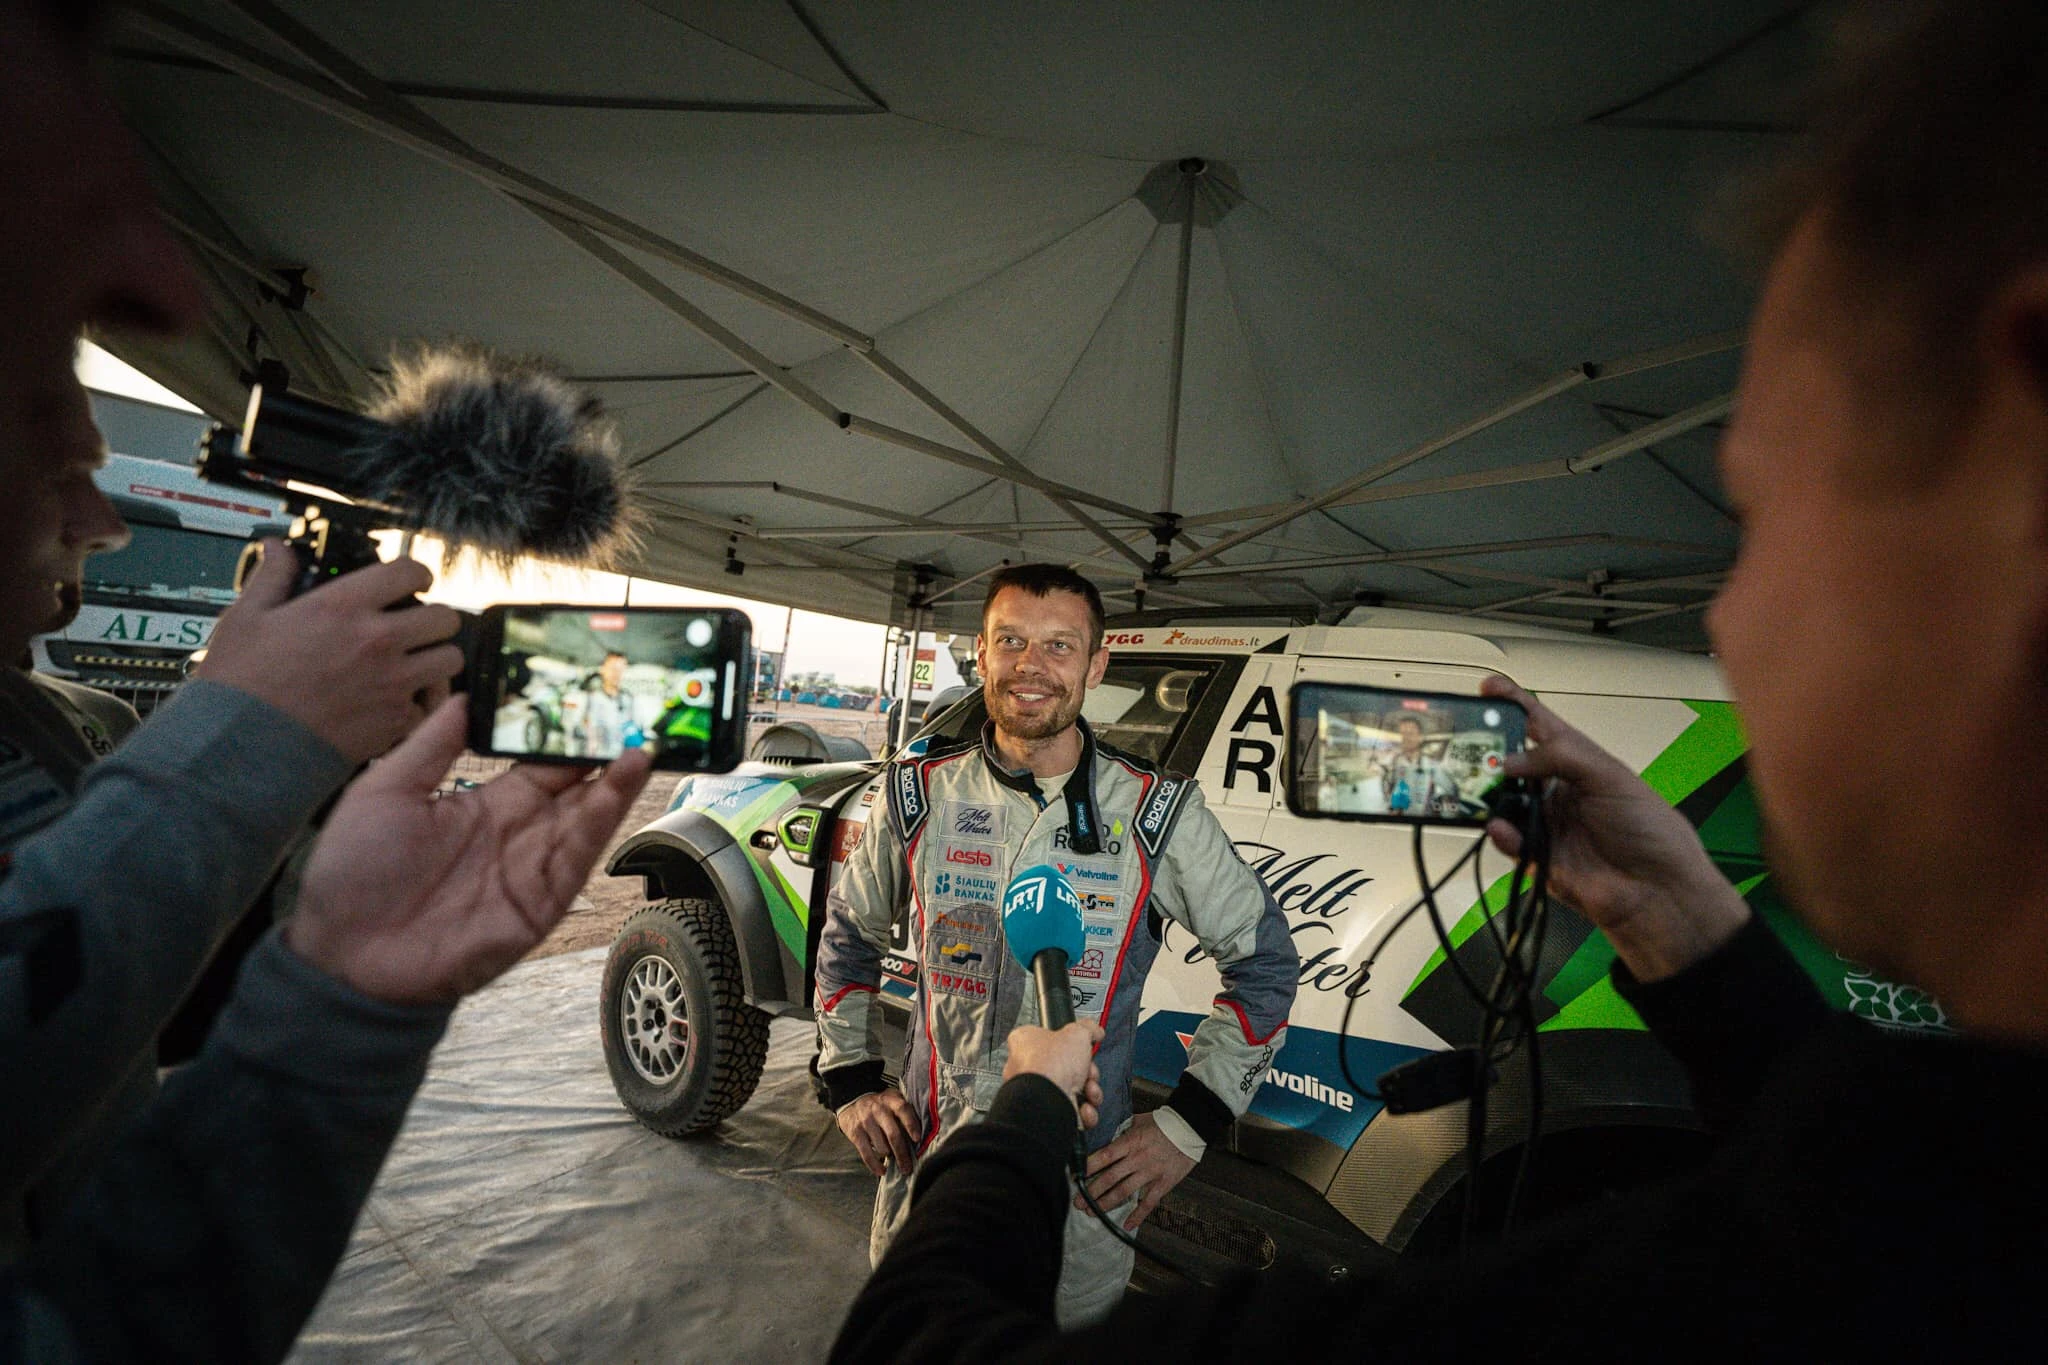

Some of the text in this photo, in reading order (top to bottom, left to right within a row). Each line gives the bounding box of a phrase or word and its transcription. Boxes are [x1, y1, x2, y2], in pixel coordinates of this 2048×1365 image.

[102, 612, 208, 646] AL-S
[1178, 633, 1261, 647] draudimas.lt
[902, 766, 919, 815] sparco
[1144, 780, 1175, 830] sparco
[1076, 868, 1118, 881] Valvoline
[954, 888, 995, 902] BANKAS
[1004, 885, 1039, 919] LRT
